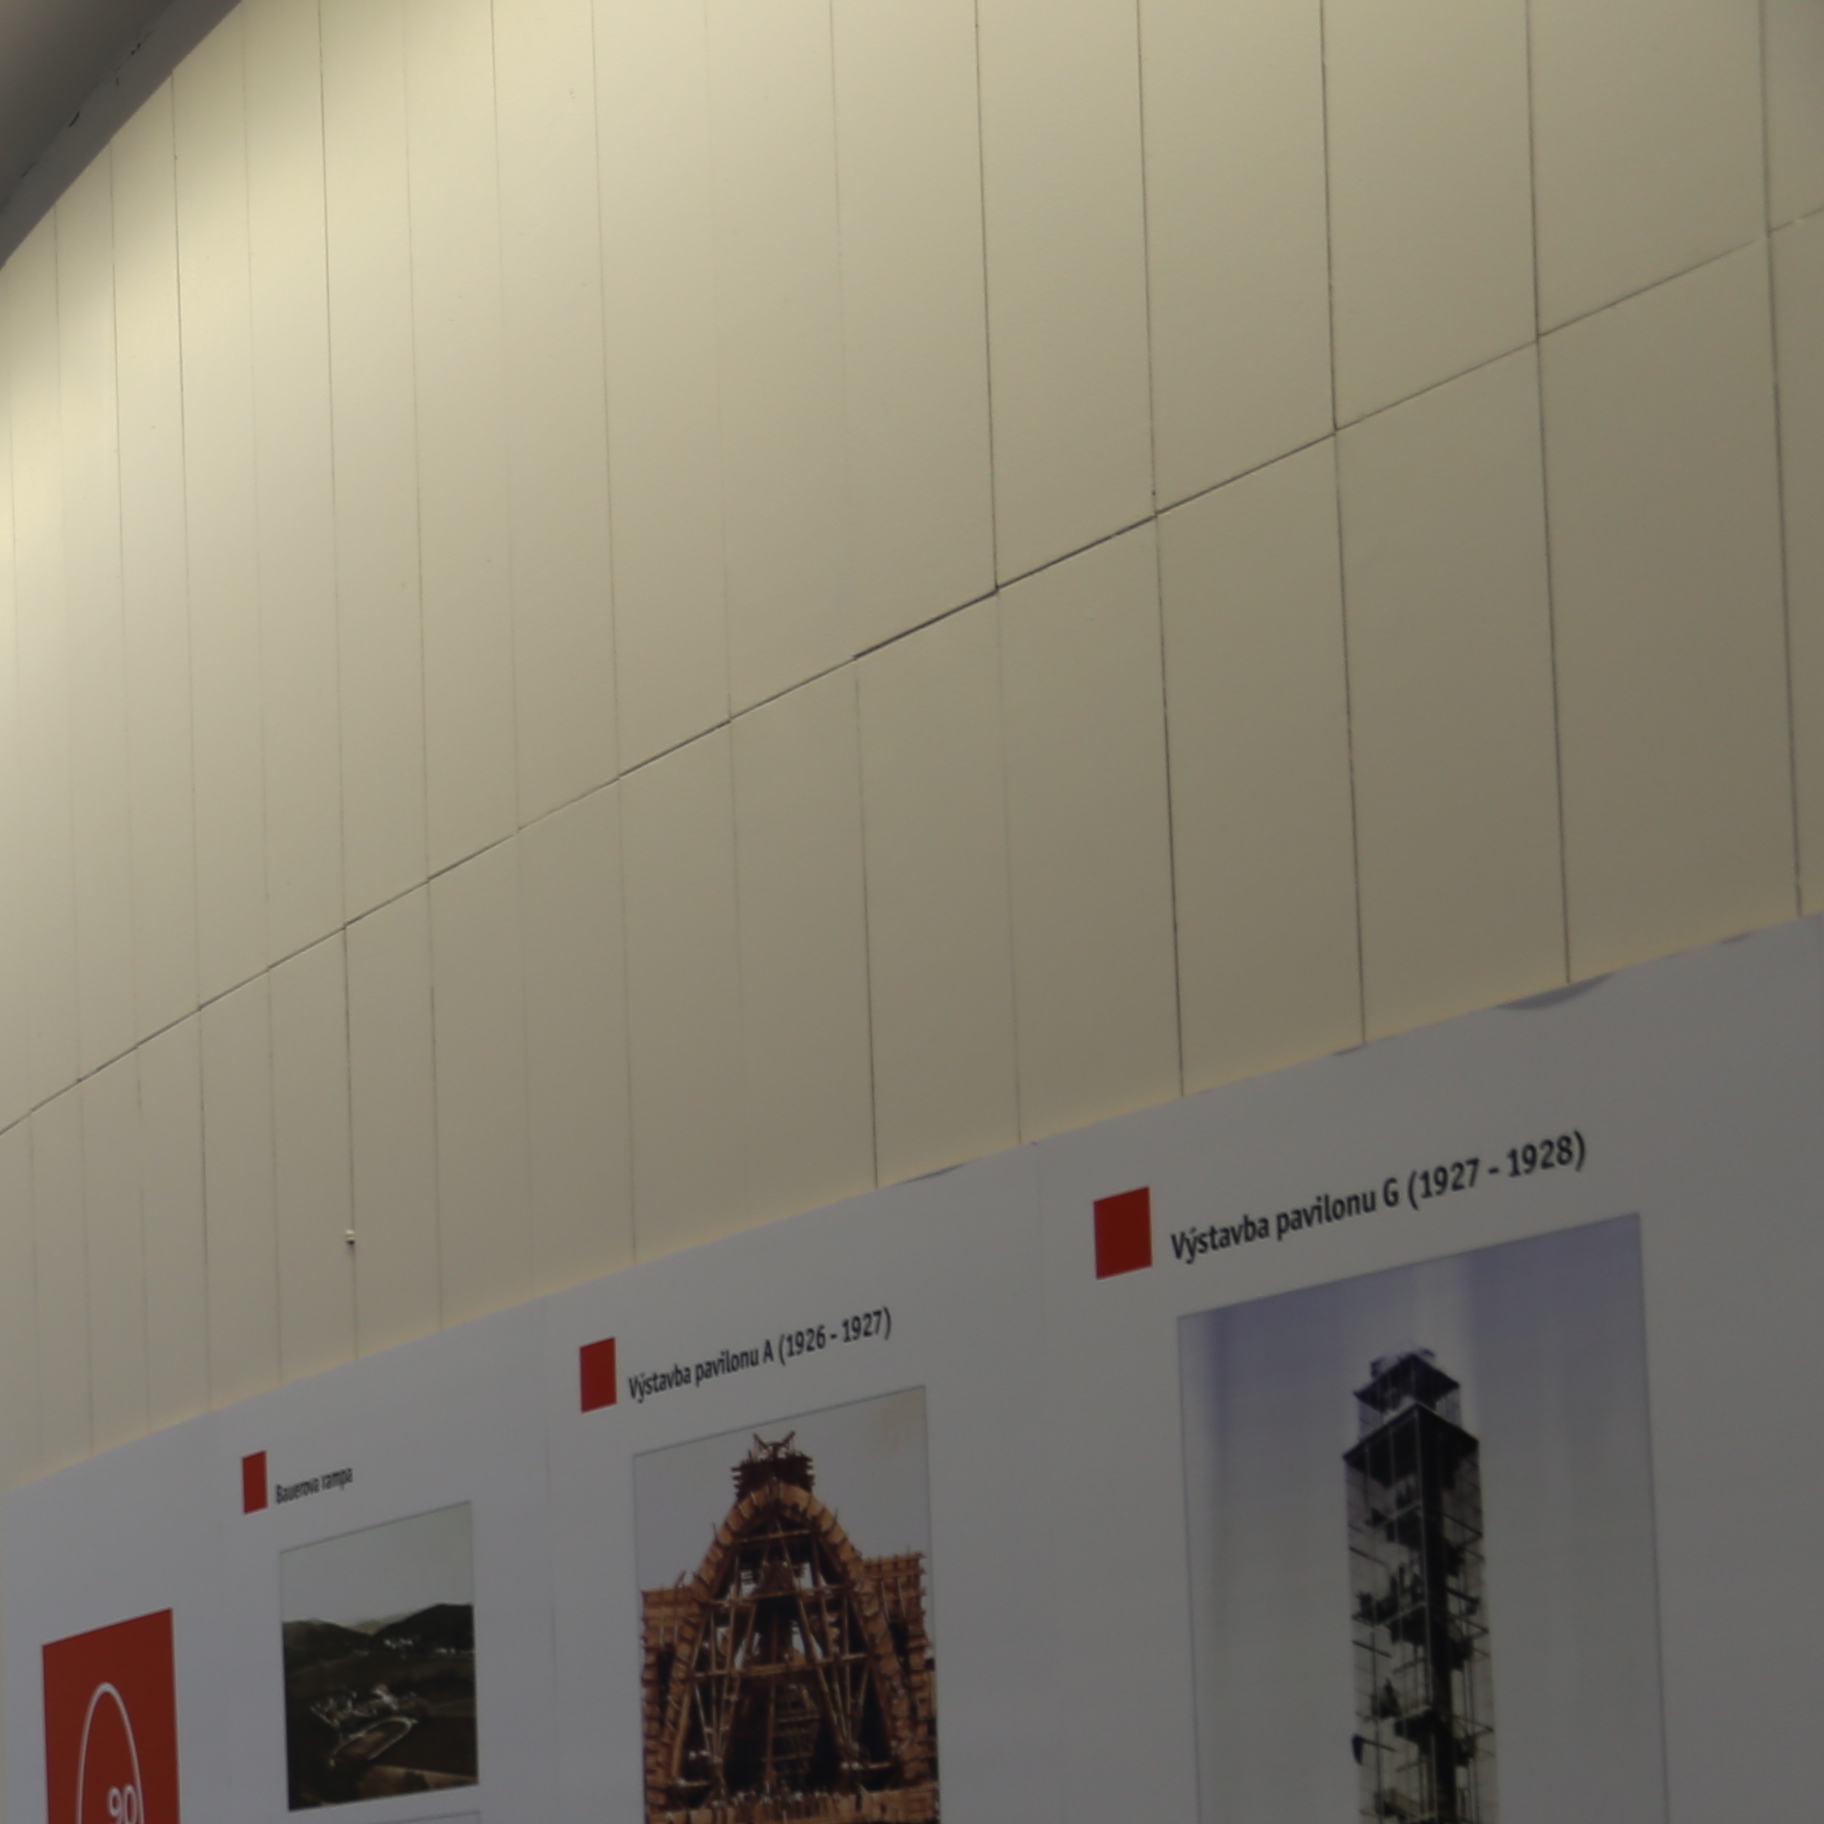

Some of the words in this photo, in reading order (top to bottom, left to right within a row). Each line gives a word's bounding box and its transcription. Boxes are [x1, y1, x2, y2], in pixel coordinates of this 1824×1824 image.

[1169, 1213, 1270, 1266] Výstavba
[1275, 1189, 1377, 1242] pavilonu
[1381, 1176, 1400, 1209] G
[1407, 1156, 1481, 1211] (1927
[1506, 1129, 1587, 1179] 1928)
[627, 1363, 692, 1404] Výstavba
[694, 1347, 759, 1388] pavilonu
[762, 1338, 775, 1364] A
[777, 1324, 827, 1367] (1926
[841, 1305, 893, 1344] 1927)
